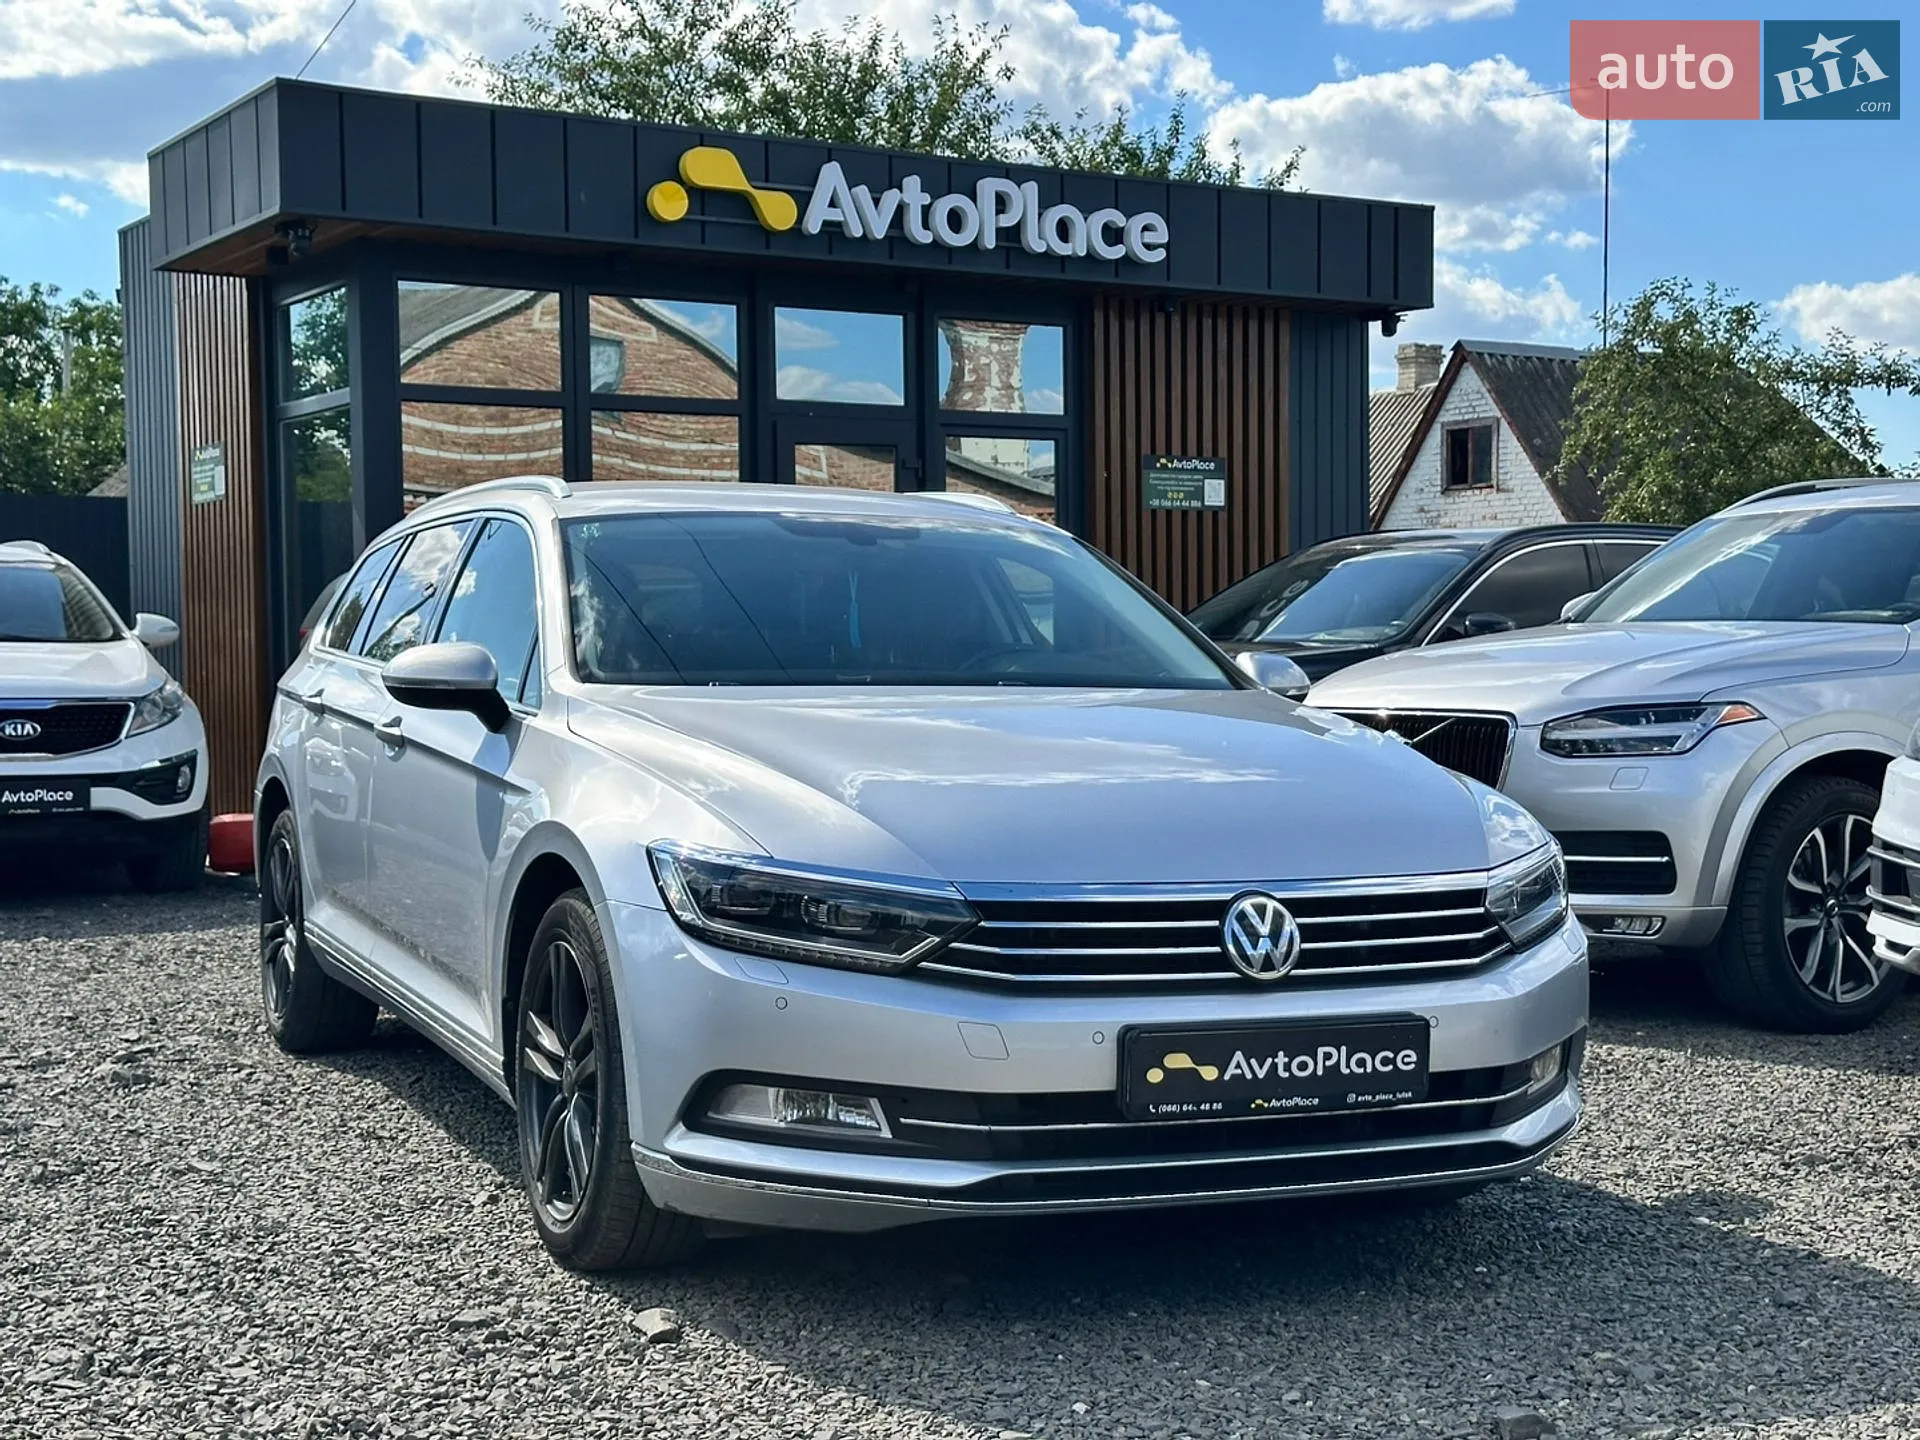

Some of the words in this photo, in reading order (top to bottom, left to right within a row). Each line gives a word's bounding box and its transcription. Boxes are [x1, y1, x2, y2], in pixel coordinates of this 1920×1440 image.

[802, 160, 1169, 264] AvtoPlace
[1172, 459, 1215, 470] AvtoPlace
[4, 723, 35, 736] KIA
[2, 789, 74, 803] AvtoPlace
[1223, 1046, 1418, 1081] AvtoPlace
[1269, 1096, 1319, 1108] AvtoPlace
